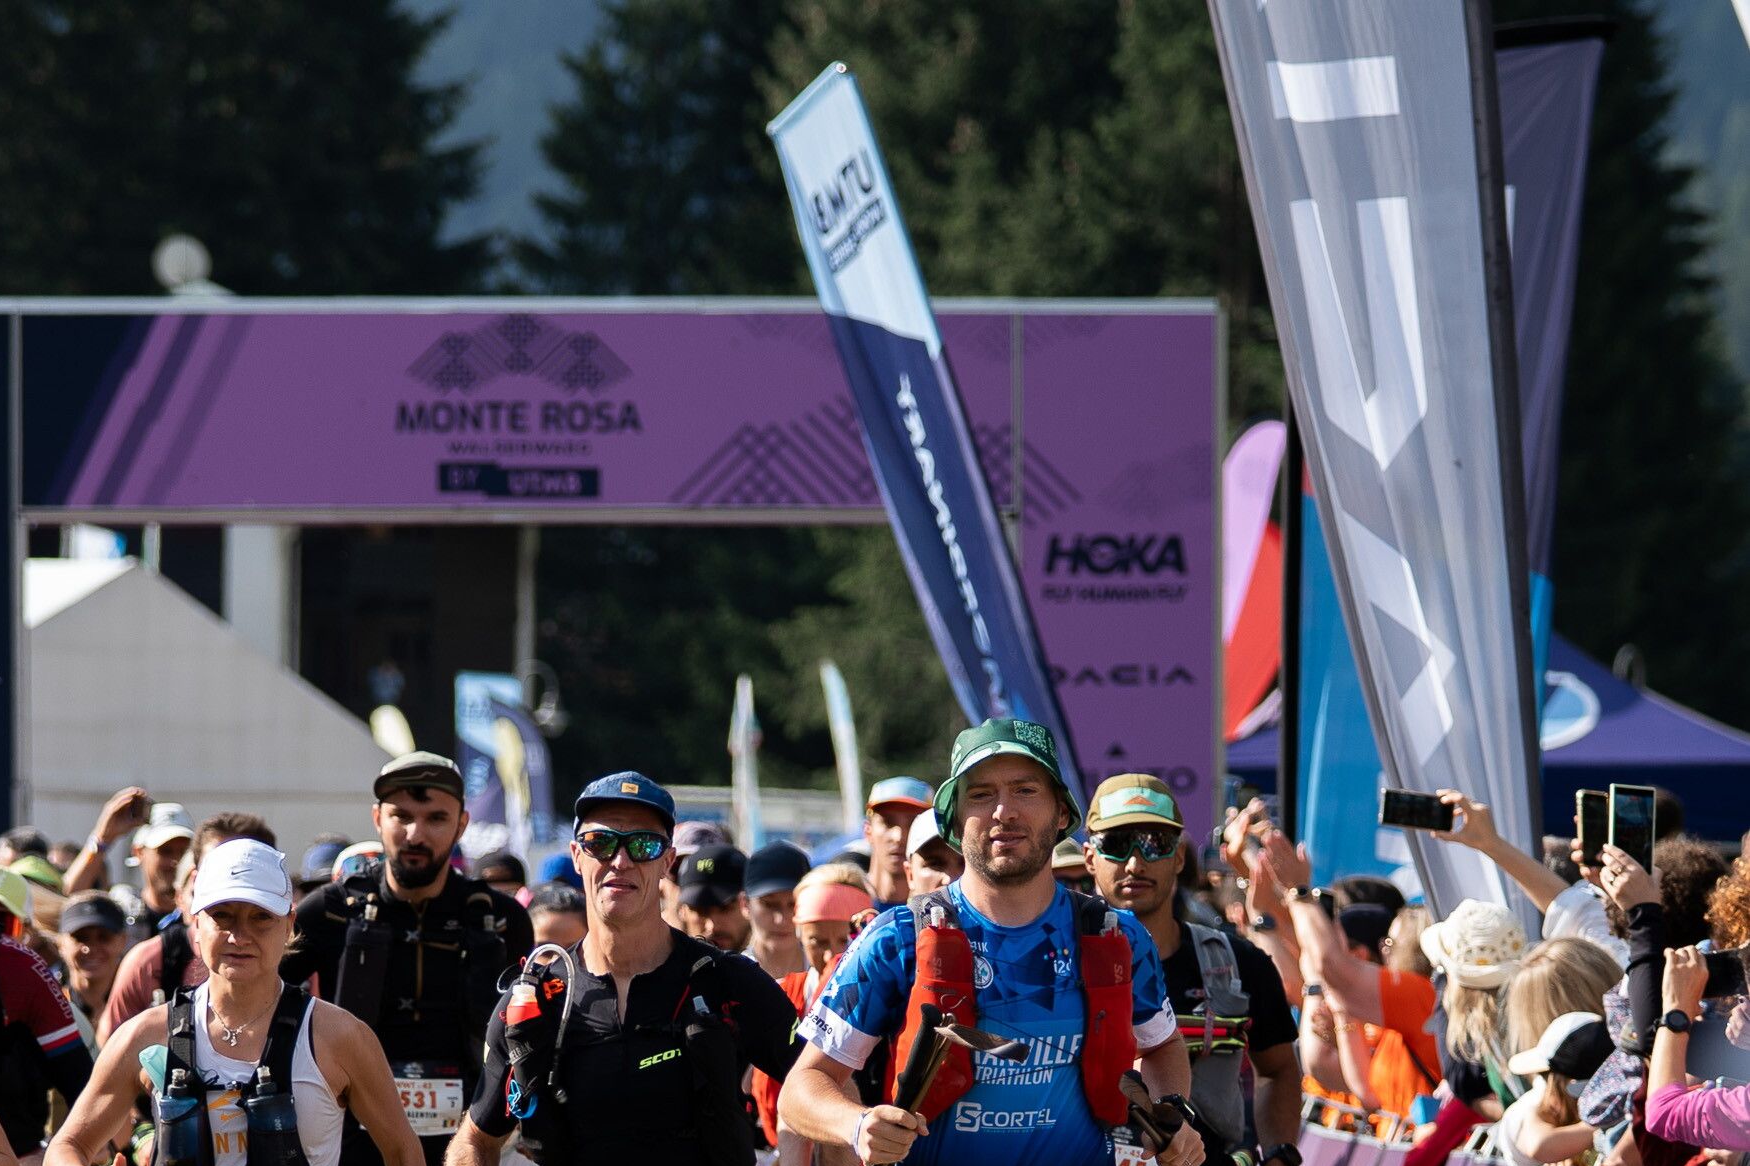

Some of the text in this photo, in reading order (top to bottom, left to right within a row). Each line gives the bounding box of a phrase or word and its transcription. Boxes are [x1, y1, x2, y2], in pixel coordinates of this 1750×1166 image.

[396, 400, 644, 434] MONTE ROSA
[1045, 533, 1188, 576] HOKA
[639, 1048, 682, 1069] SCO
[975, 1066, 1054, 1086] TRIATHLON
[401, 1091, 437, 1109] 531
